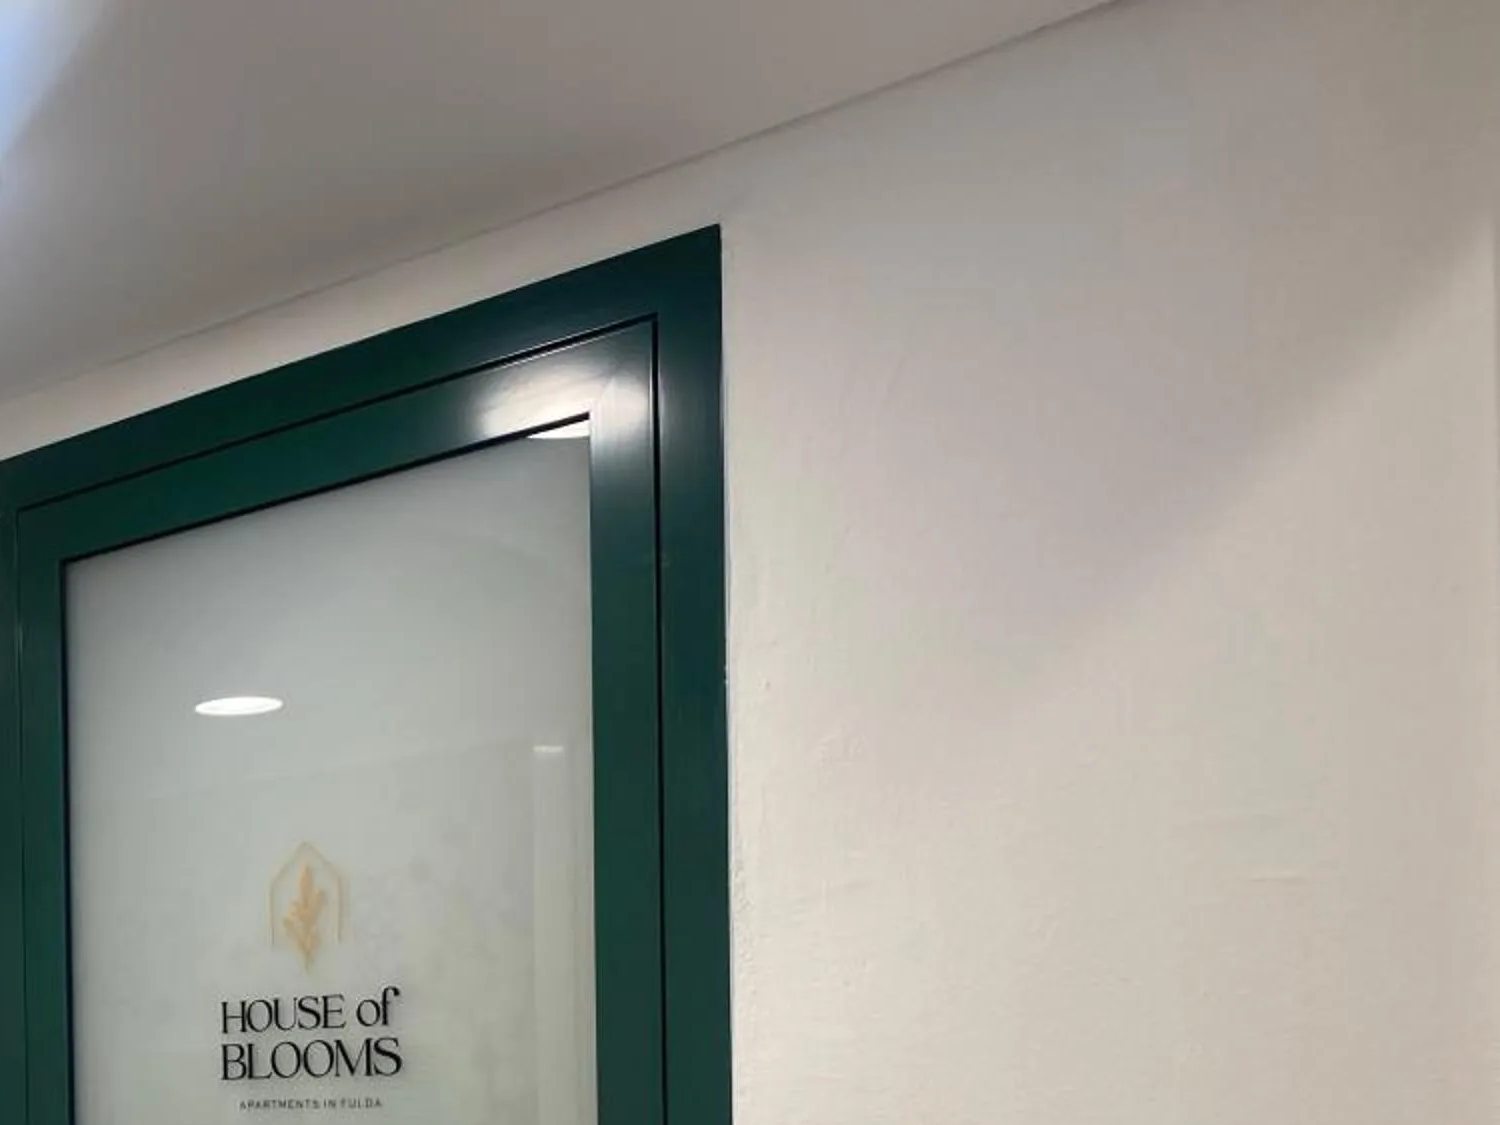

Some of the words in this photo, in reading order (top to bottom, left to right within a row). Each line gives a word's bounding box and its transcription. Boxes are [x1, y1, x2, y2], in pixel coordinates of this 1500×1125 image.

[221, 994, 347, 1034] HOUSE
[355, 985, 400, 1027] of
[221, 1037, 403, 1080] BLOOMS
[239, 1098, 320, 1110] APARTMENTS
[323, 1099, 337, 1109] IN
[341, 1097, 382, 1109] FULDA
